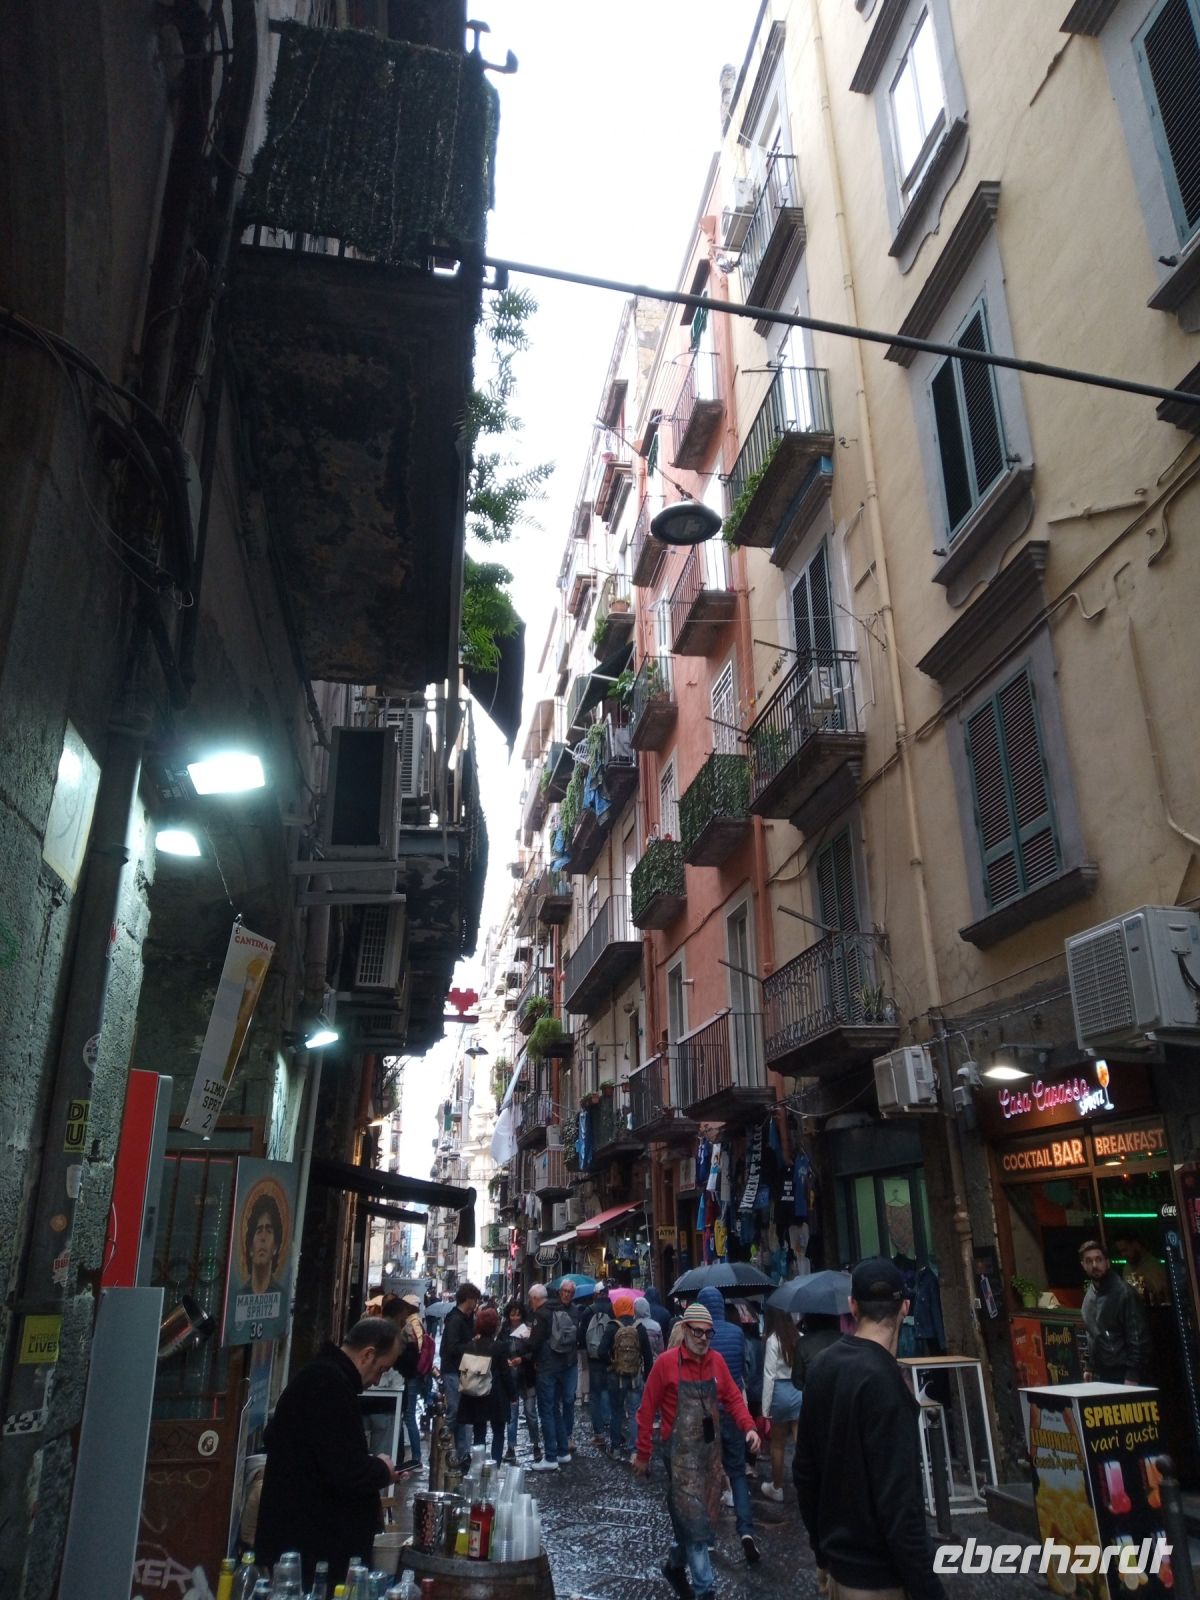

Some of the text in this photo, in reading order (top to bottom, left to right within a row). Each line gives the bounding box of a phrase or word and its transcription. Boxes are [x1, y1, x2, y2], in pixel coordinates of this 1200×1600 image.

[235, 935, 269, 951] CANTINA
[998, 1089, 1032, 1119] Casa
[1002, 1138, 1086, 1172] COCKTAIL BAR
[1094, 1129, 1164, 1157] BREAKFAST
[236, 1294, 279, 1306] MARADONA
[246, 1304, 273, 1318] SPRITZ
[1083, 1400, 1161, 1429] SPREMUTE
[1090, 1421, 1160, 1453] vari gusti
